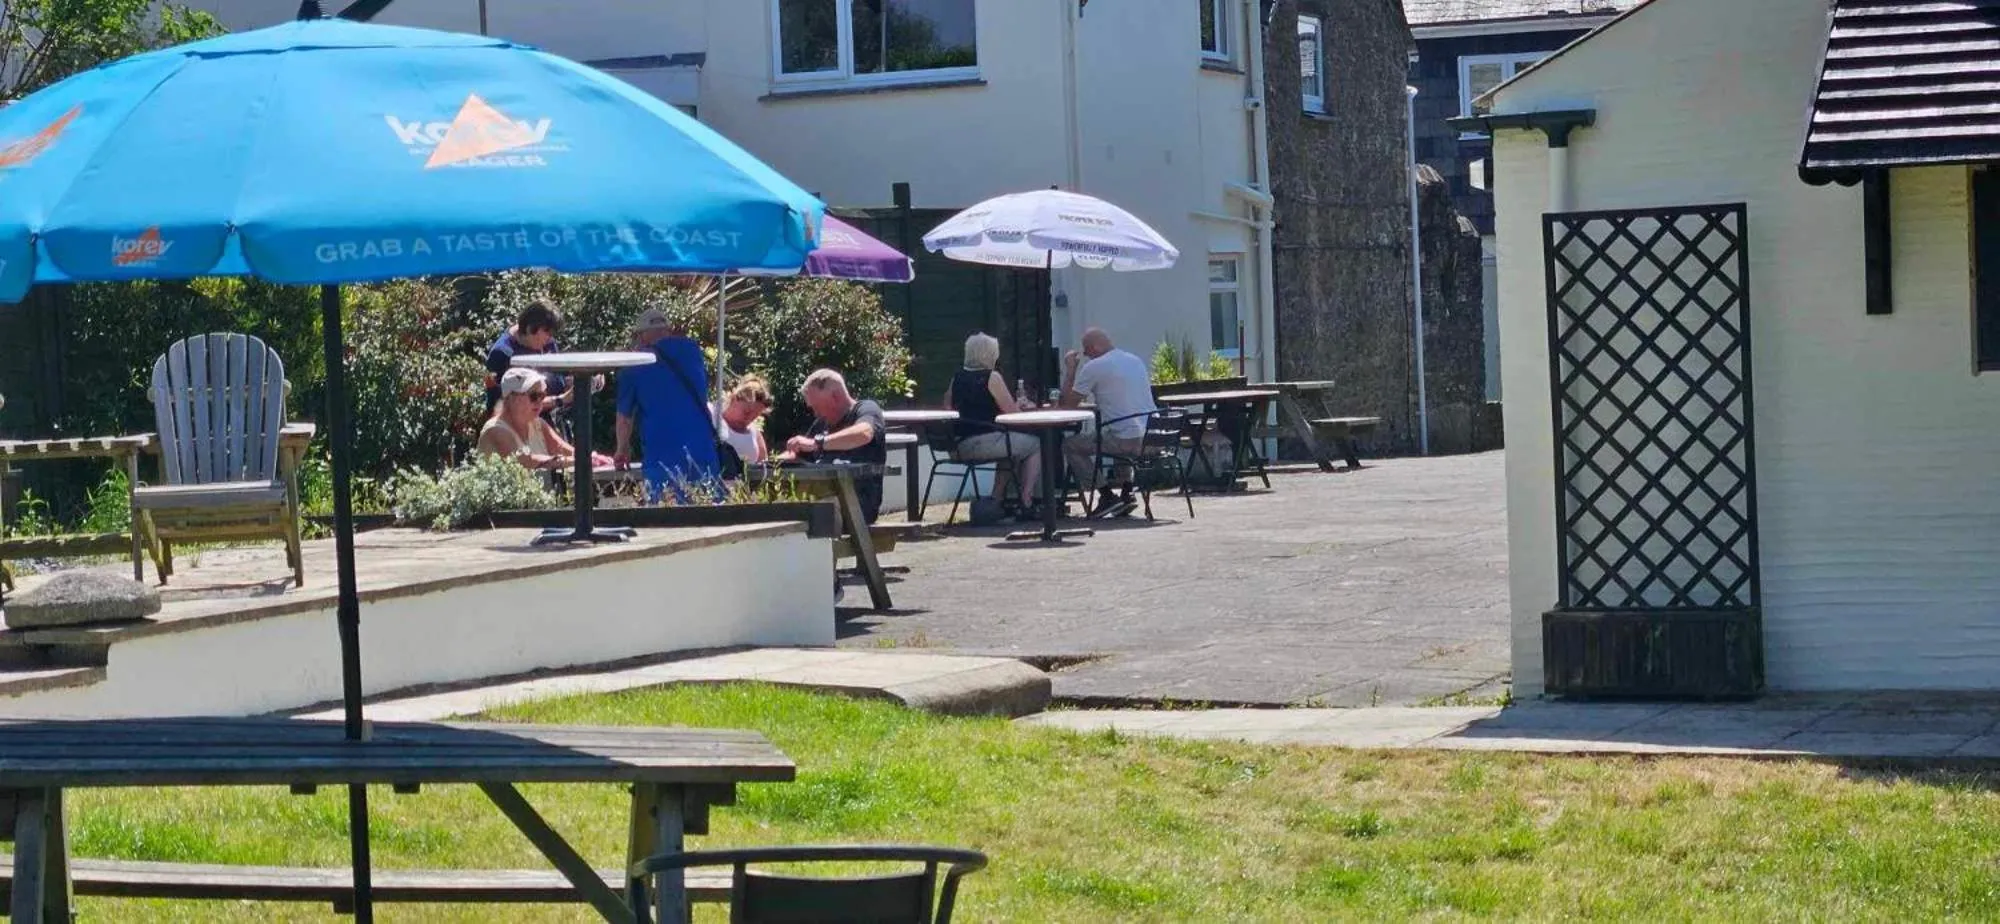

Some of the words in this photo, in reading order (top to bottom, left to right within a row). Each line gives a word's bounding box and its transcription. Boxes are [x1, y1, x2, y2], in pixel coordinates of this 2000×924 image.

[315, 238, 403, 263] GRAB
[411, 237, 432, 257] A
[438, 229, 530, 252] TASTE
[539, 229, 577, 248] OF
[587, 227, 640, 247] THE
[650, 228, 743, 249] COAST
